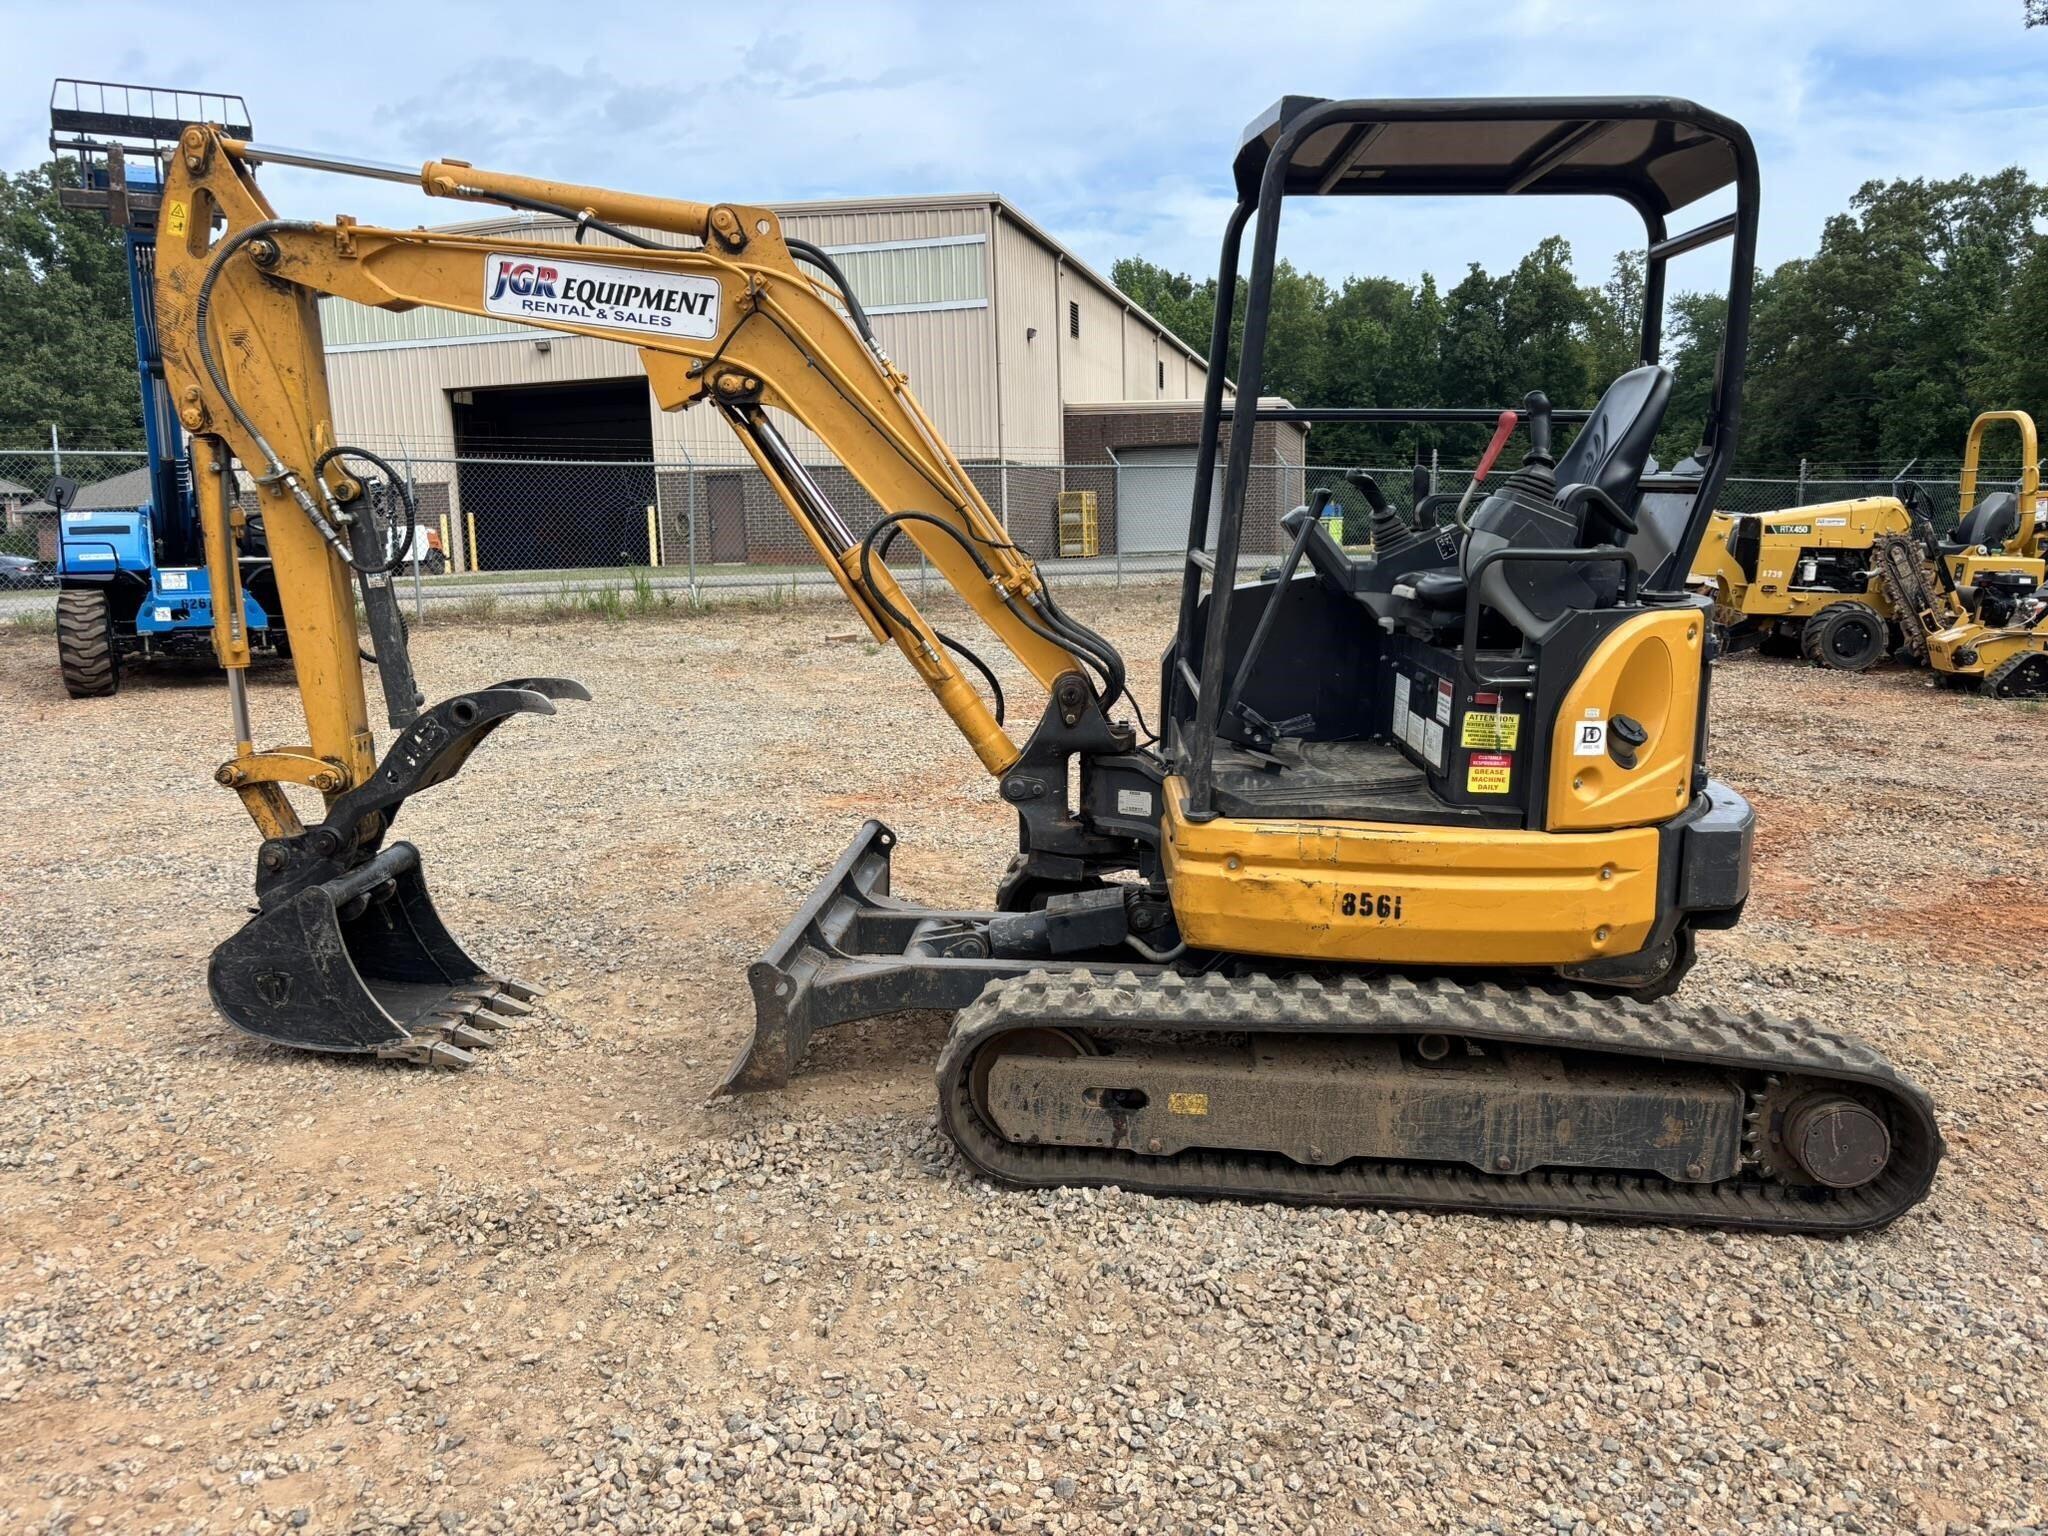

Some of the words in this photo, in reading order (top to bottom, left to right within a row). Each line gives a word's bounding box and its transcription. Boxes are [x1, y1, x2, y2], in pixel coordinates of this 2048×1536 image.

[490, 261, 558, 300] JGR
[561, 278, 715, 316] EQUIPMENT
[522, 300, 592, 318] RENTAL
[596, 308, 608, 320] &
[614, 310, 672, 327] SALES
[1469, 714, 1514, 722] ATTENION
